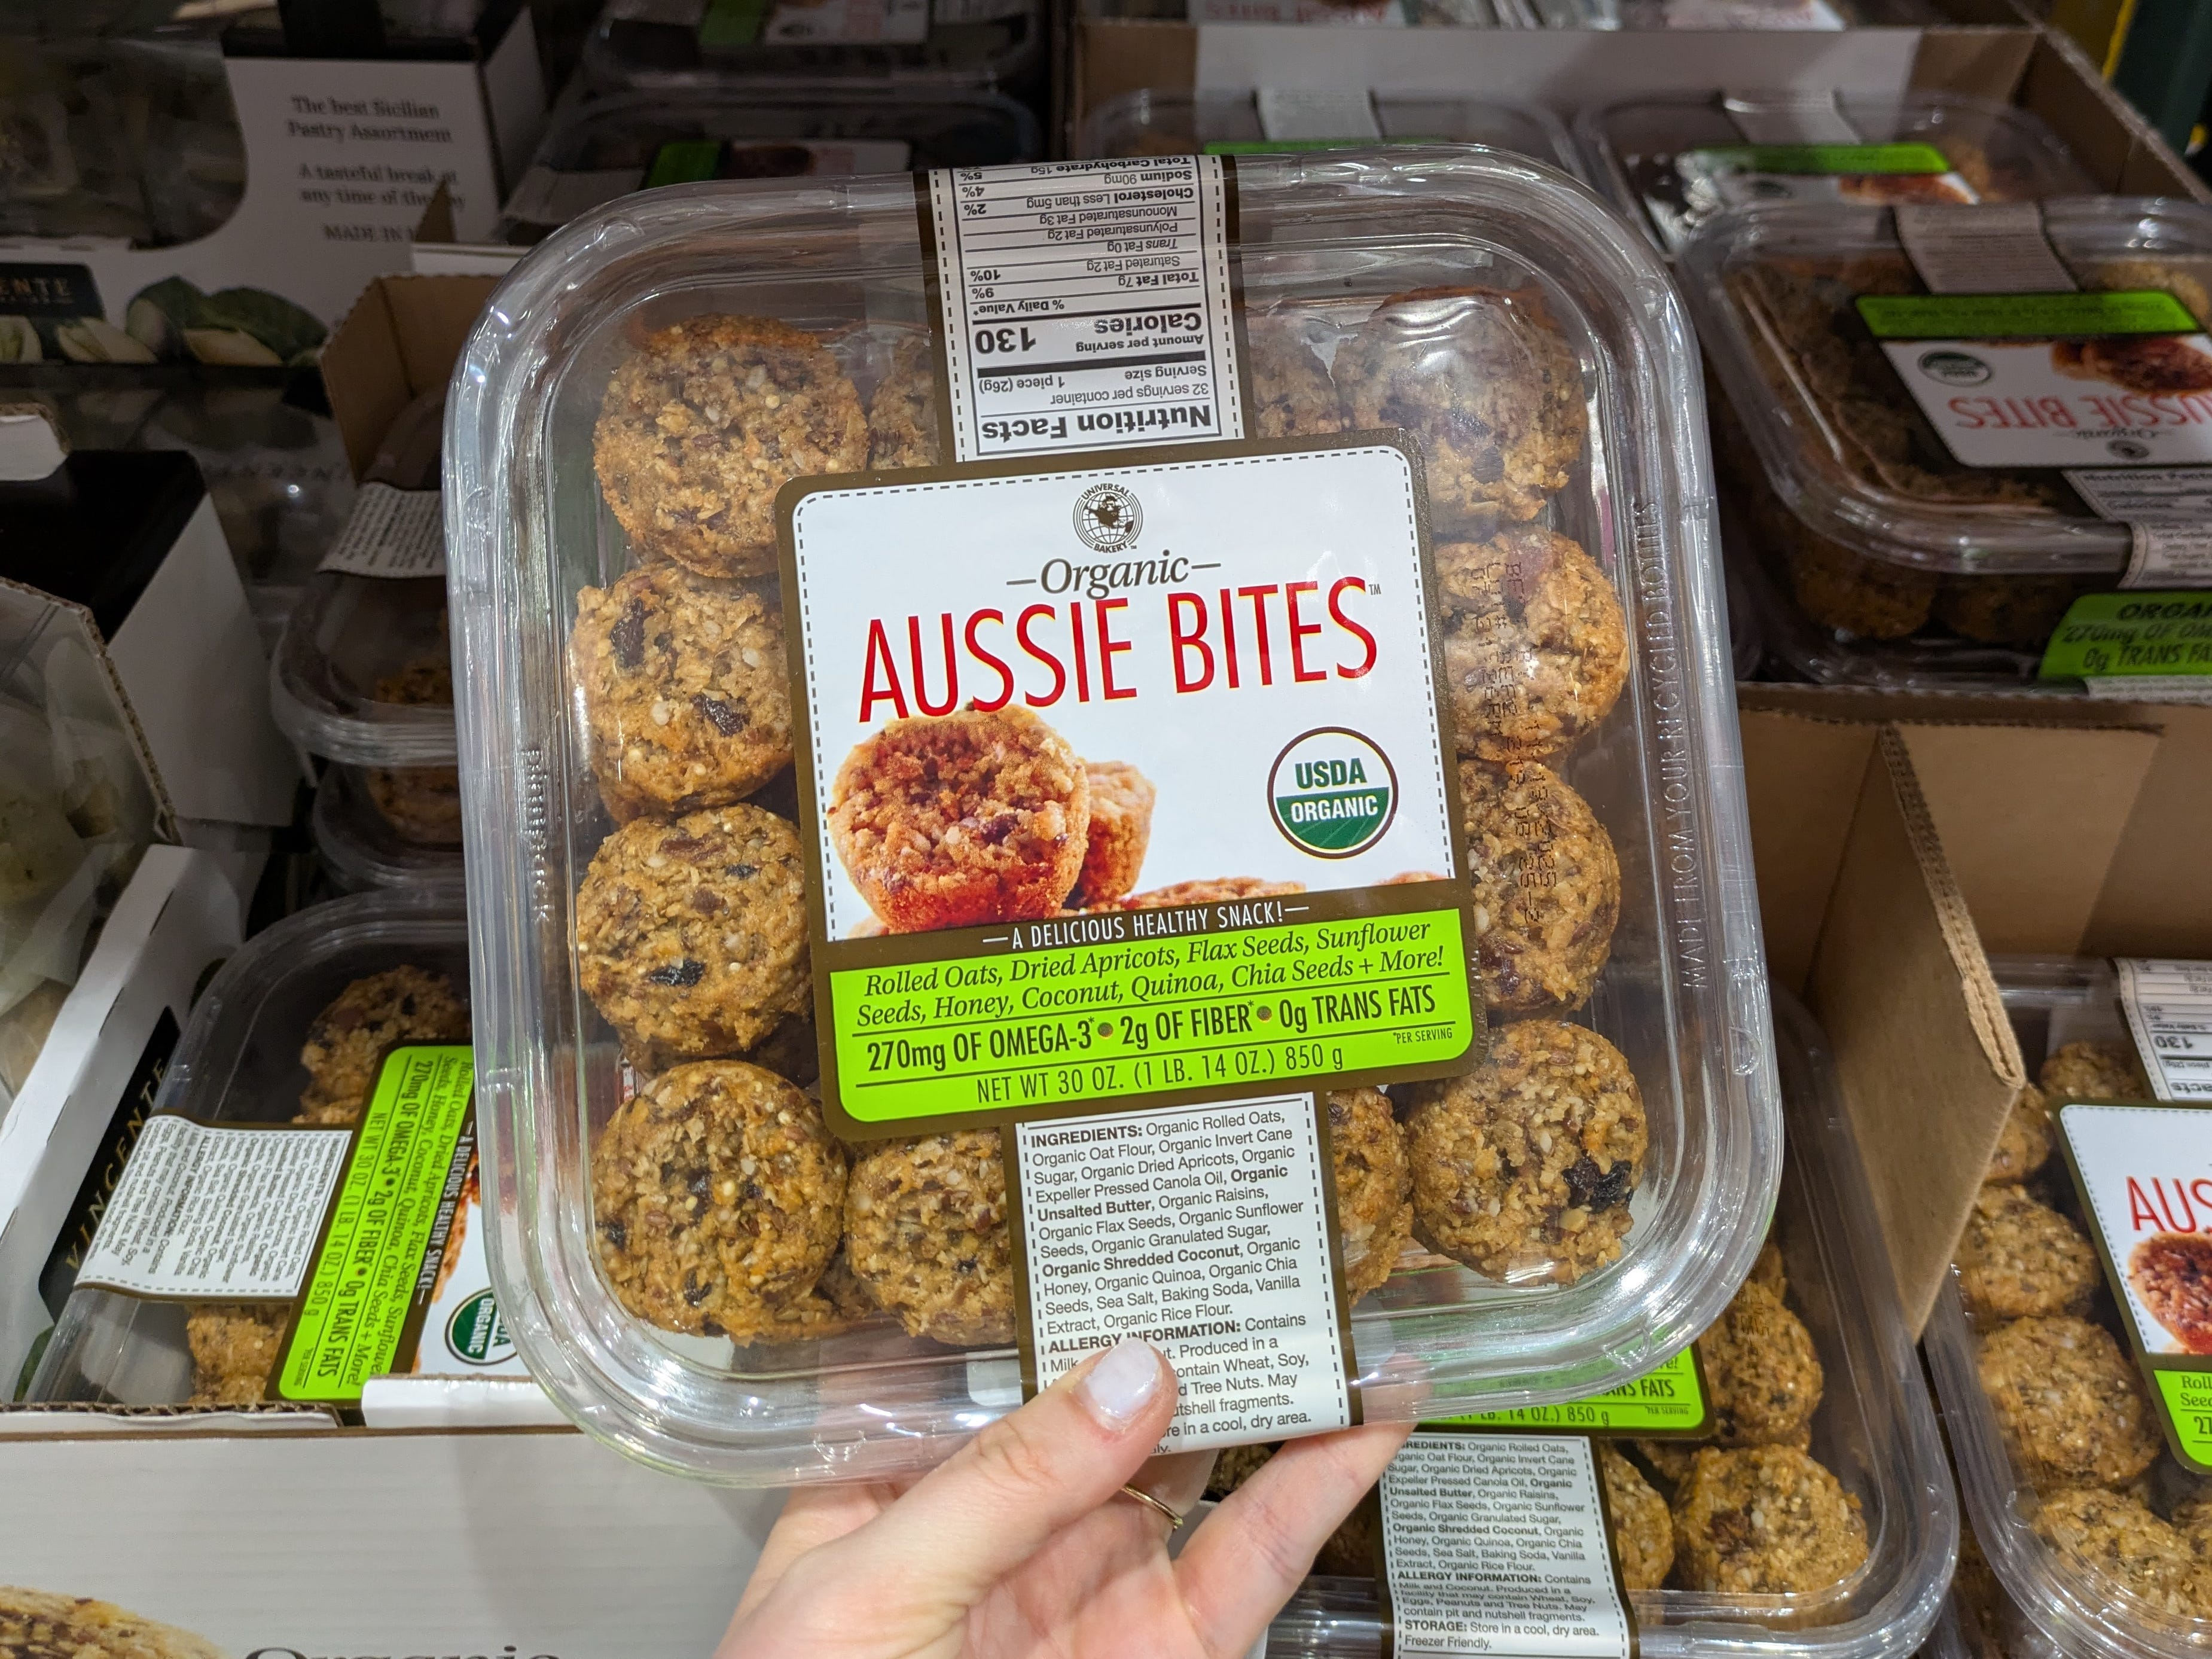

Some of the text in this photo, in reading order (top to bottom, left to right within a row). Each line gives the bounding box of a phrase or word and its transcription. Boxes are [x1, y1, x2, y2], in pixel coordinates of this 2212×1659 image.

[964, 187, 1194, 216] Cholesterol Less than 5mg 2%
[970, 256, 1180, 282] Saturated Fat 2g 10%
[972, 272, 1200, 300] Total Fat 7g 9%
[975, 312, 1202, 354] Calories 130
[1075, 334, 1204, 353] Amount per serving
[979, 375, 1065, 395] 1 piece (26g)
[1124, 365, 1207, 382] Serving size
[1050, 383, 1209, 406] 32 servings per container
[981, 405, 1212, 443] Nutrition Facts
[1081, 483, 1131, 501] UNIVERSAL
[1094, 540, 1129, 554] BAKERY
[1041, 548, 1189, 600] Organic
[859, 597, 1137, 724] AUSSIE
[1167, 576, 1378, 695] BITES
[1295, 757, 1368, 789] USDA
[1660, 749, 1693, 821] YOUR
[1290, 795, 1378, 824] ORGANIC
[1012, 901, 1283, 949] A DELICIOUS HEALTHY SNACK!
[864, 923, 1431, 997] Rolled Oats, Dried Apricots, Flax Seeds, Sunflower
[857, 998, 926, 1028] Seeds,
[933, 995, 1015, 1020] Honey,
[1022, 981, 1124, 1009] Coconut,
[1131, 972, 1224, 1002] Quinoa,
[1232, 962, 1287, 987] Chia
[1292, 954, 1354, 981] Seeds
[1379, 945, 1444, 972] More!
[867, 1039, 946, 1073] 270mg
[953, 1032, 982, 1063] OF
[1120, 1015, 1149, 1050] 2g
[1155, 1010, 1183, 1041] OF
[1279, 999, 1308, 1034] 0g
[1311, 990, 1383, 1025] TRANS
[1388, 984, 1436, 1017] FATS
[2155, 1035, 2193, 1049] 130
[401, 1060, 434, 1100] 270mg
[977, 1044, 1343, 1103] NET WT 30 OZ. (1 LB. 14 OZ.) 850 g
[400, 1103, 421, 1118] OF
[1031, 1111, 1285, 1148] INGREDIENTS: Organic Rolled Oats,
[367, 1190, 394, 1206] 2g
[366, 1208, 388, 1226] OF
[1042, 1237, 1301, 1278] Organic Shredded Coconut, Organic
[338, 1279, 366, 1297] 0g
[1045, 1275, 1301, 1316] Seeds, Sea Salt, Baking Soda, Vanilla
[328, 1301, 359, 1344] TRANS
[467, 1297, 495, 1354] ORGANIC
[1048, 1315, 1307, 1353] ALLERGY FORMATION: Contains
[317, 1347, 344, 1377] FATS
[1640, 1379, 1674, 1398] FATS
[1567, 1407, 1595, 1422] 850
[1601, 1411, 1610, 1427] g
[1398, 1572, 1591, 1585] ALLERGY INFORMATION: Contains
[1405, 1620, 1467, 1632] STORAGE:
[1470, 1622, 1499, 1633] Store
[1502, 1623, 1512, 1633] in
[1524, 1624, 1549, 1636] cool,
[1553, 1626, 1570, 1638] dry
[1573, 1628, 1599, 1636] area.
[1405, 1634, 1491, 1651] Freezer Friendly.
